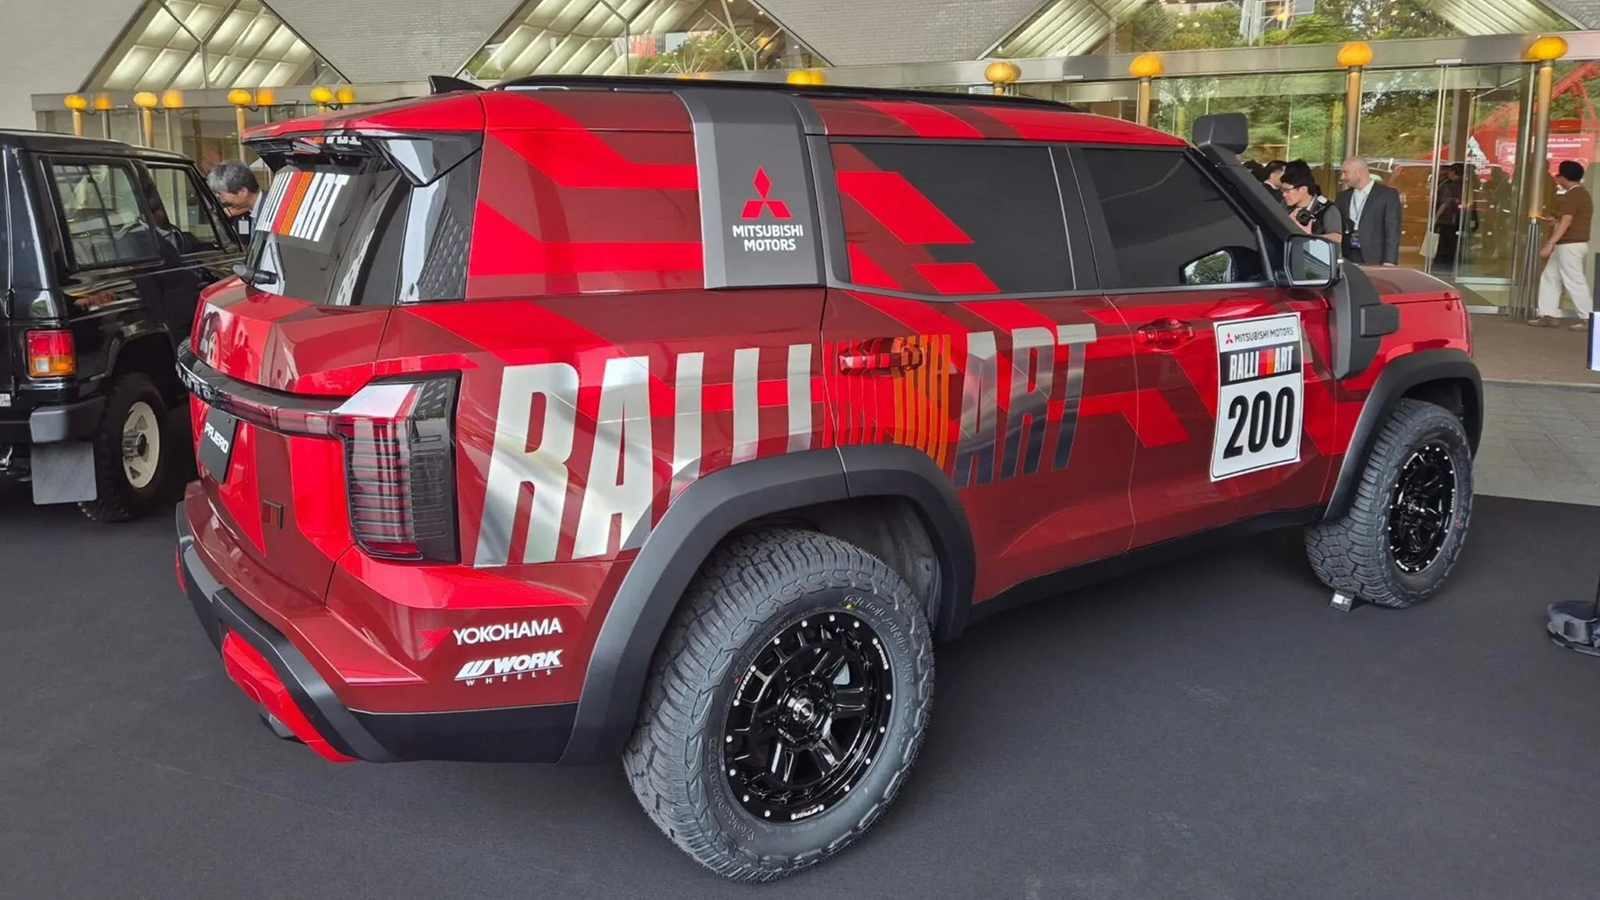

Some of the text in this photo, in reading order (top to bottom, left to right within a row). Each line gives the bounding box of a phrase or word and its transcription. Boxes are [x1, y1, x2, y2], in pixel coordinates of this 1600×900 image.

[732, 225, 804, 237] MITSUBISHI
[743, 239, 796, 251] MOTORS
[1234, 326, 1294, 344] MITSUBISHI MOTORS
[1223, 386, 1295, 459] 200
[204, 422, 229, 453] PAJERO
[453, 617, 563, 645] YOKOHAMA
[494, 649, 563, 674] WORK
[466, 668, 552, 686] WHEELS
